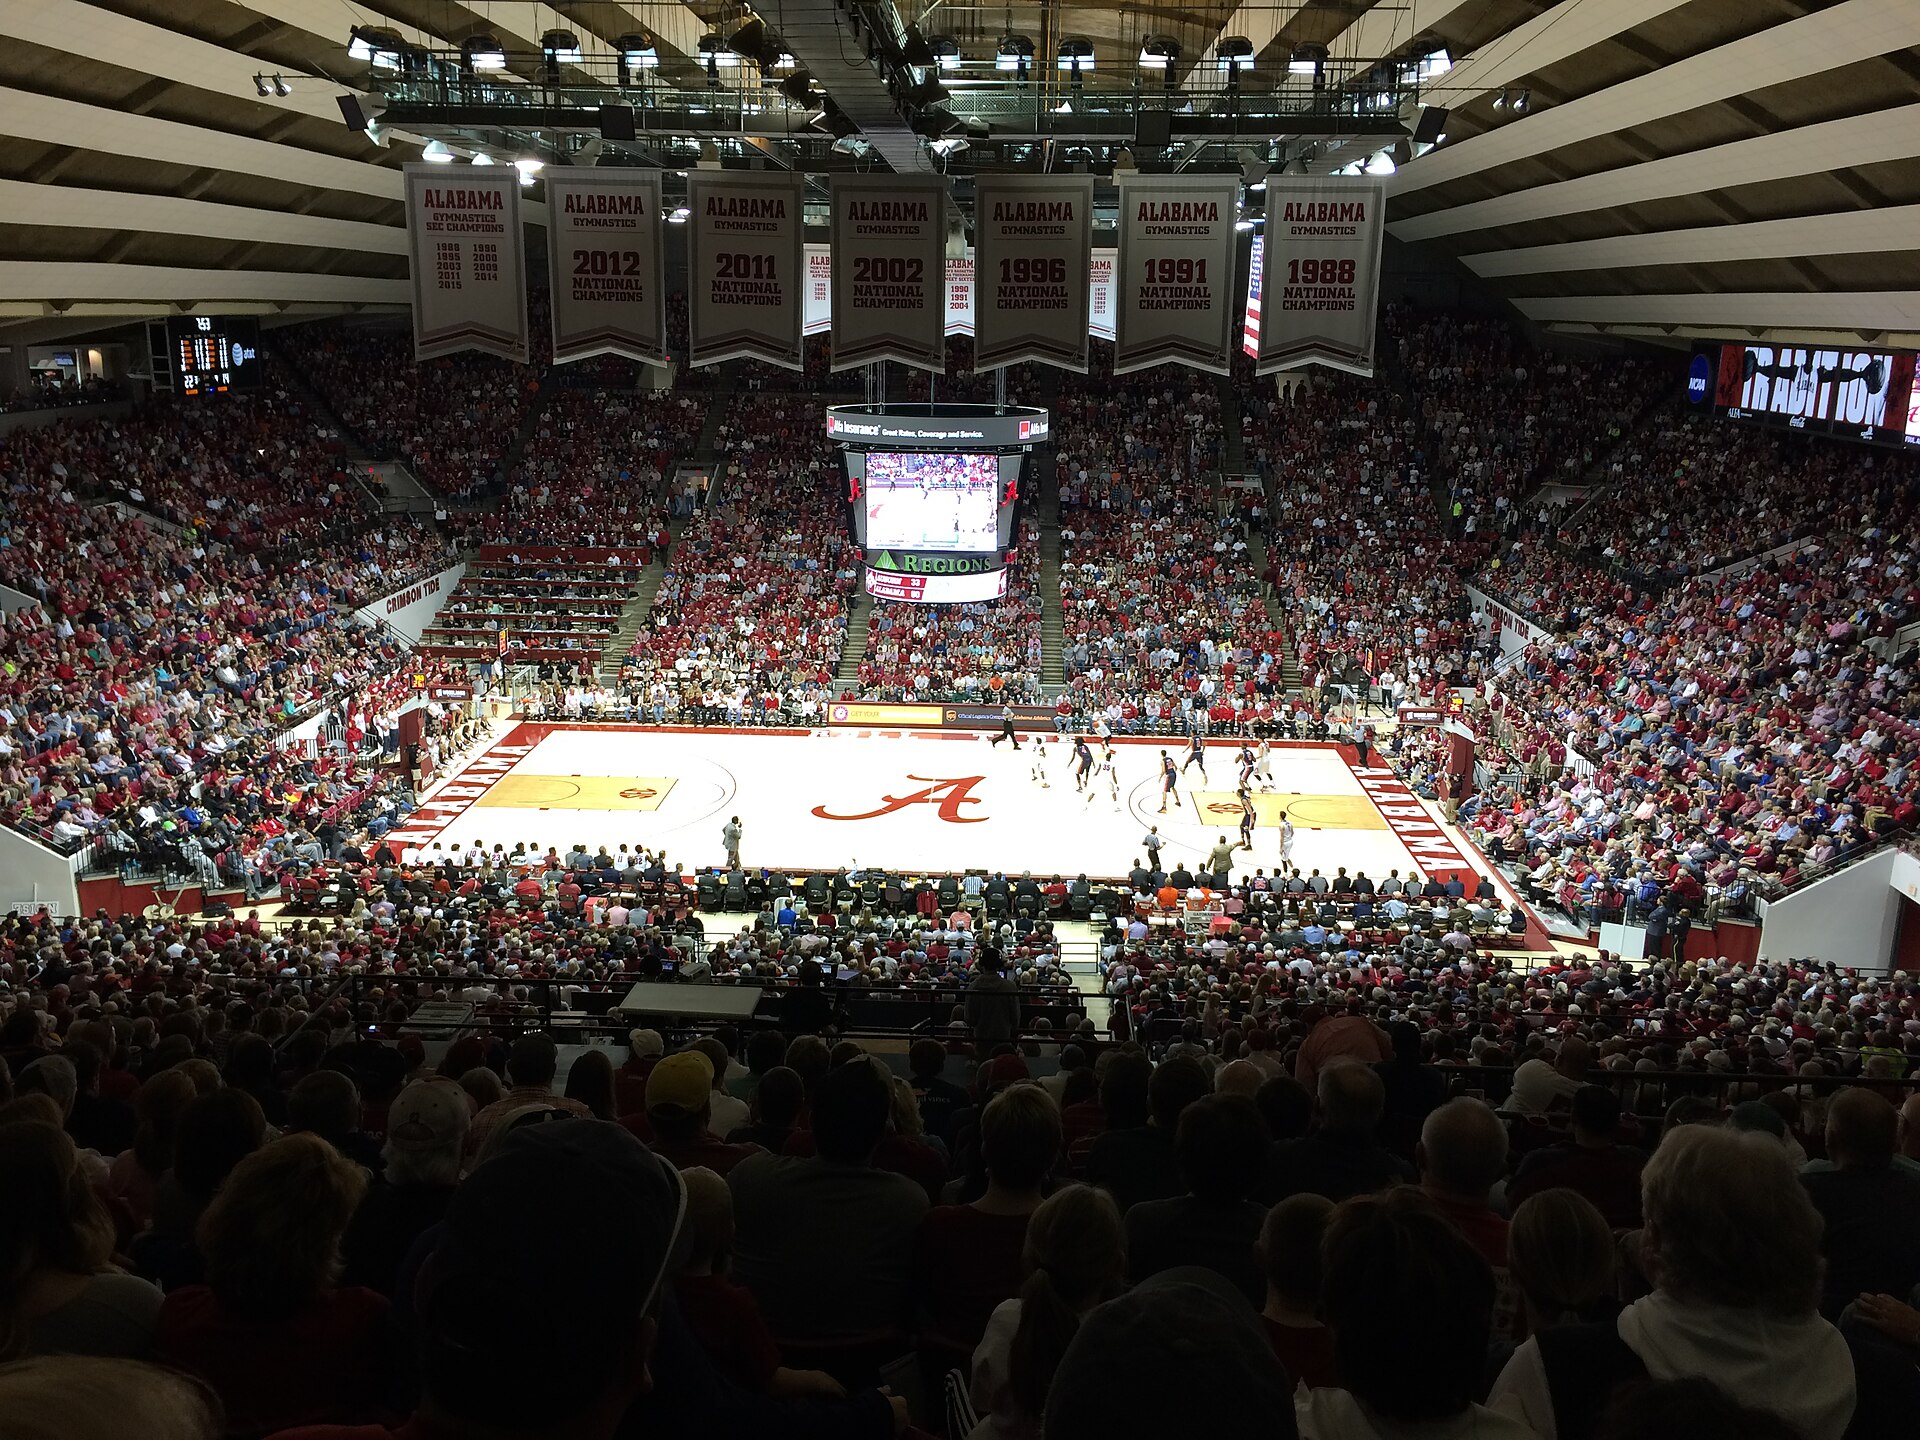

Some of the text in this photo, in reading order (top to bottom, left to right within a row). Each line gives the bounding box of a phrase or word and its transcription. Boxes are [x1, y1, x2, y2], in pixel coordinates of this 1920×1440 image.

[424, 189, 503, 210] ALABAMA
[565, 194, 644, 215] ALABAMA
[706, 197, 786, 219] ALABAMA
[848, 202, 929, 222] ALABAMA
[993, 202, 1073, 223] ALABAMA
[1137, 202, 1219, 222] ALABAMA
[1283, 202, 1366, 222] ALABAMA
[433, 212, 496, 223] GYMNASTICS
[573, 217, 636, 228] GYMNASTICS
[426, 222, 504, 233] SEC CHAMPIONS
[714, 221, 778, 232] GYMNASTICS
[856, 225, 920, 235] GYMNASTICS
[1001, 226, 1065, 236] GYMNASTICS
[1145, 226, 1210, 236] GYMNASTICS
[1290, 226, 1356, 236] GYMNASTICS
[573, 250, 640, 276] 2012
[716, 253, 776, 280] 2011
[945, 259, 975, 268] LABAM
[853, 257, 923, 283] 2002
[1000, 258, 1066, 284] 1996
[1144, 258, 1207, 284] 1991
[1287, 259, 1357, 285] 1988
[438, 280, 462, 289] 2015
[572, 278, 642, 291] NATIONAL
[711, 281, 782, 294] NATIONAL
[951, 285, 969, 293] 1990
[573, 291, 643, 302] CHAMPIONS
[853, 285, 923, 298] NATIONAL
[997, 286, 1068, 298] NATIONAL
[1139, 286, 1211, 298] NATIONAL
[1283, 287, 1356, 299] NATIONAL
[711, 294, 781, 306] CHAMPIONS
[853, 298, 923, 309] CHAMPIONS
[950, 302, 969, 310] 2004
[997, 299, 1068, 310] CHAMPIONS
[1139, 299, 1211, 310] CHAMPIONS
[1282, 300, 1355, 311] CHAMPIONS
[1688, 377, 1706, 392] NCAA
[1740, 346, 1893, 427] TRADITION
[386, 577, 440, 615] CRIMSON TIDE
[1514, 619, 1530, 640] TIDE
